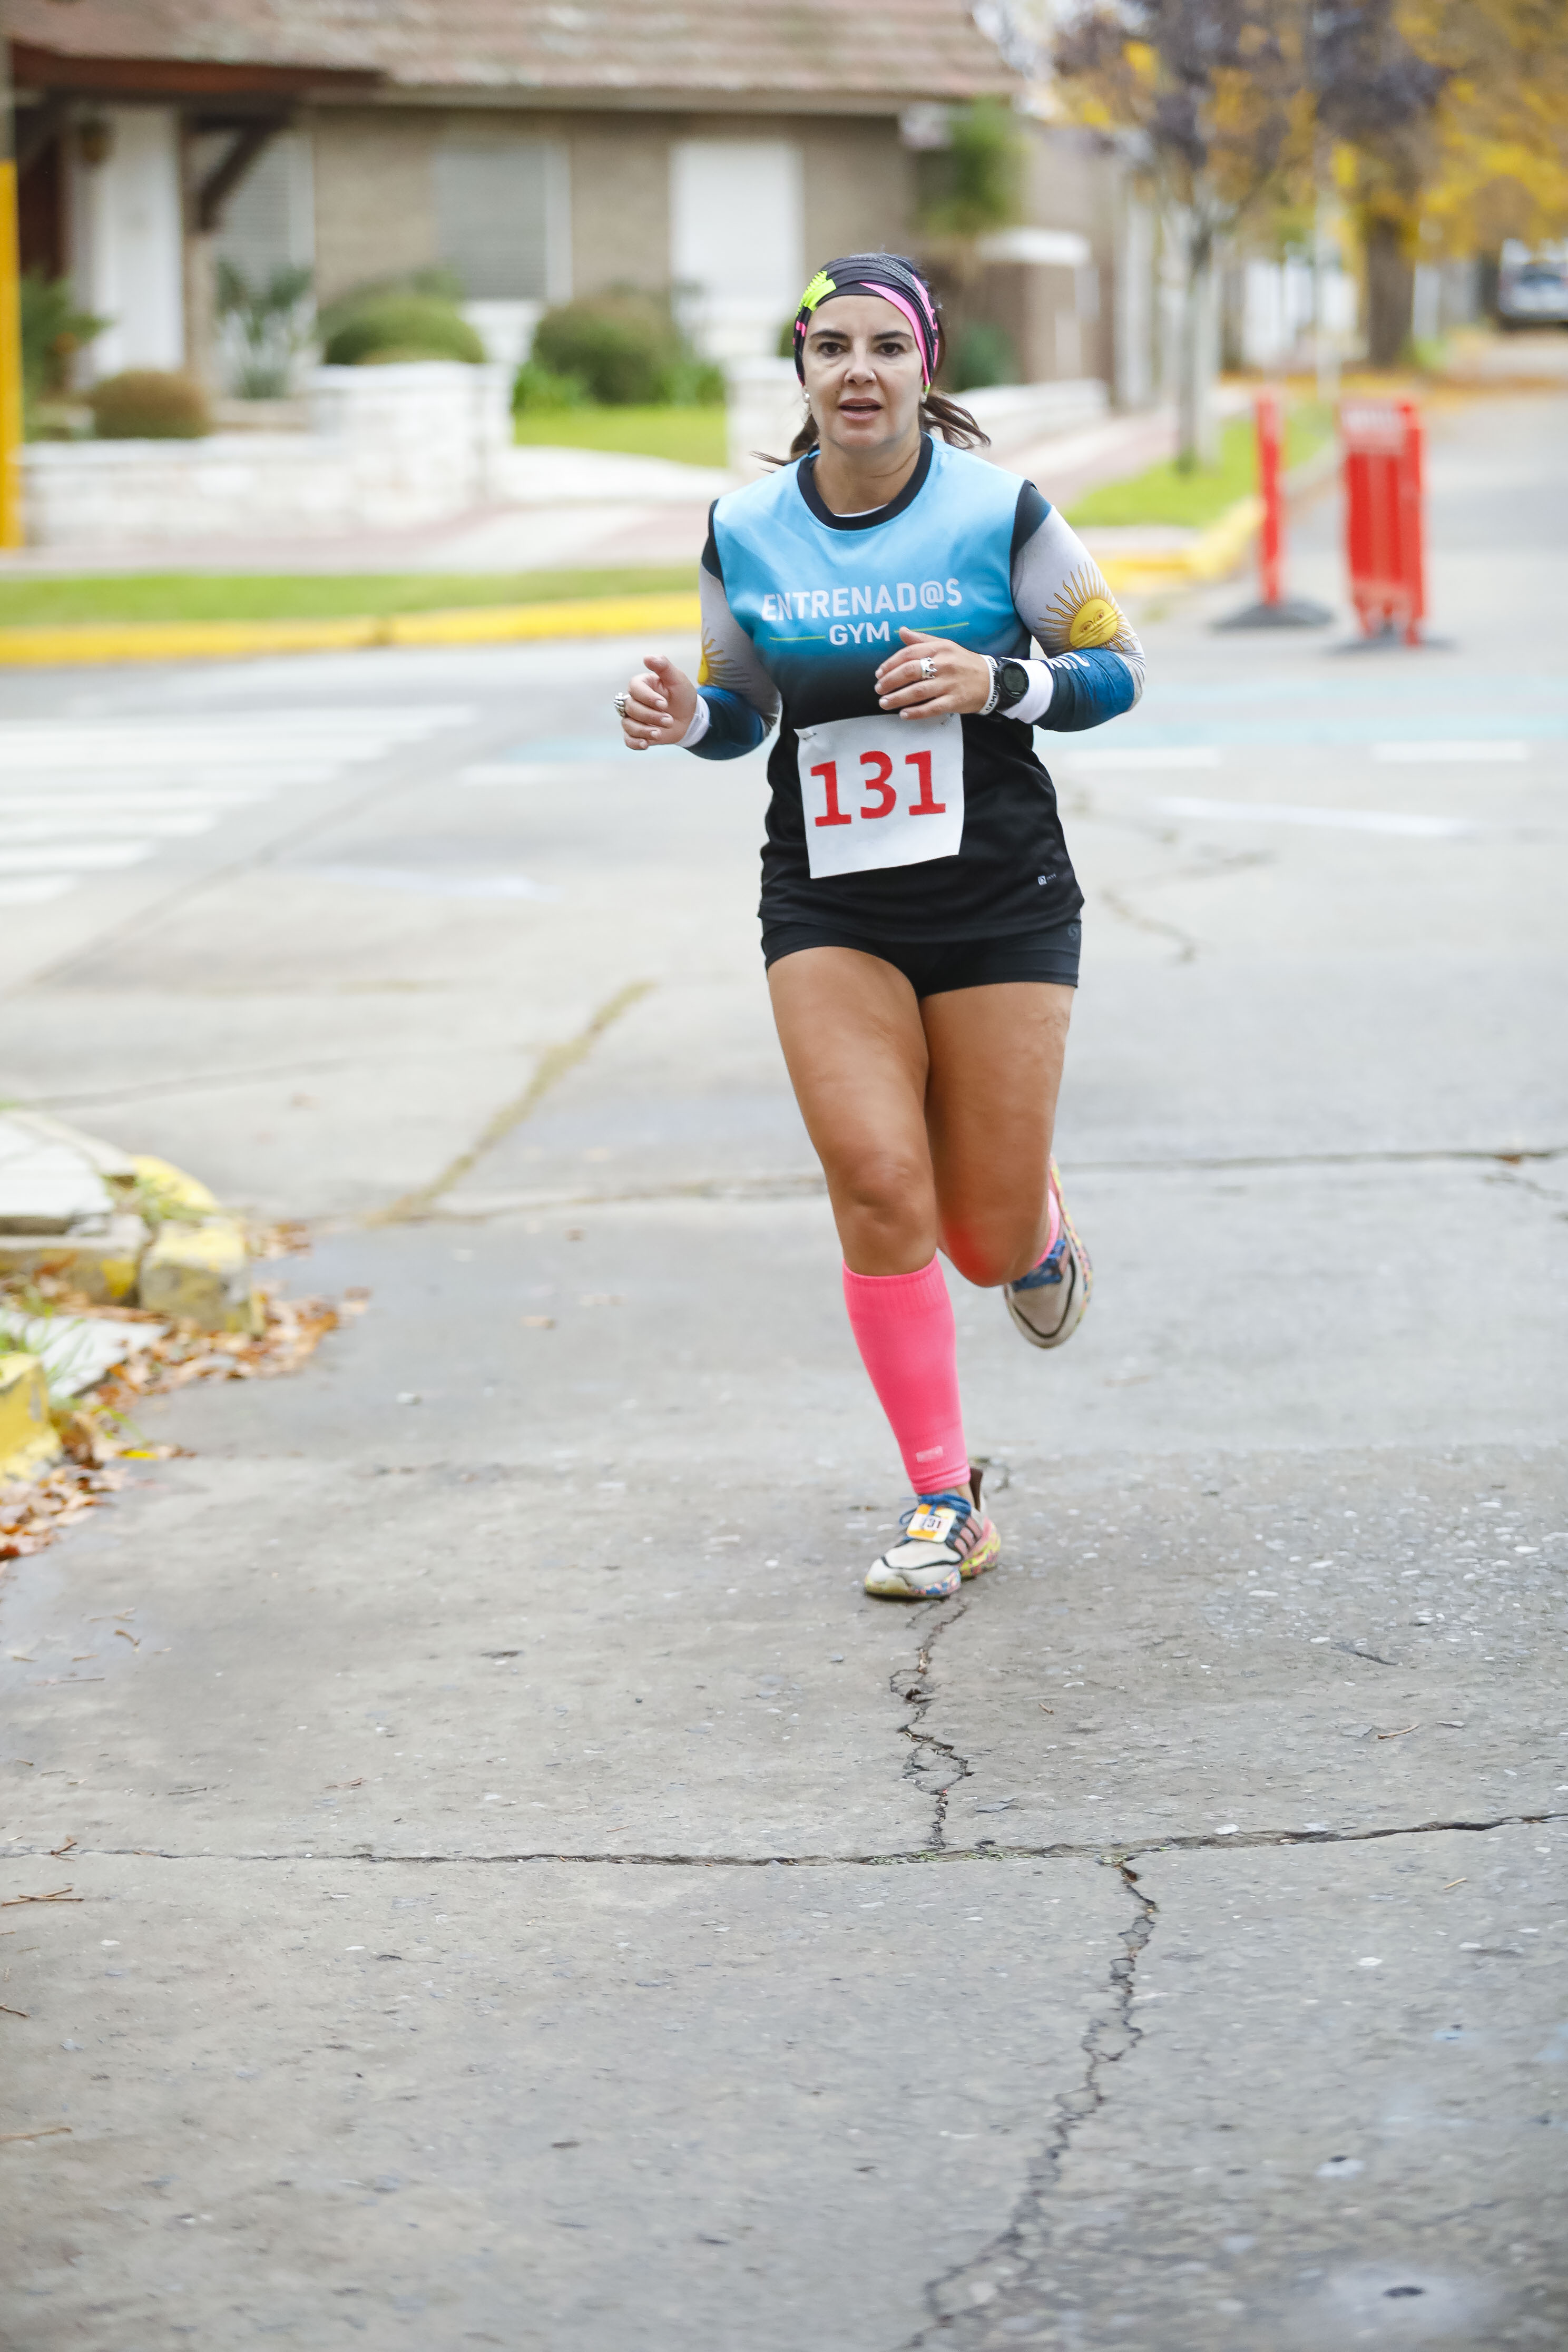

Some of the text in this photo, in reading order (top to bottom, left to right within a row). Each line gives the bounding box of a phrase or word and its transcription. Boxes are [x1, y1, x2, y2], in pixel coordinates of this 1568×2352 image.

[761, 577, 962, 621] ENTRENAD@S
[829, 621, 890, 646] GYM
[810, 750, 946, 827] 131
